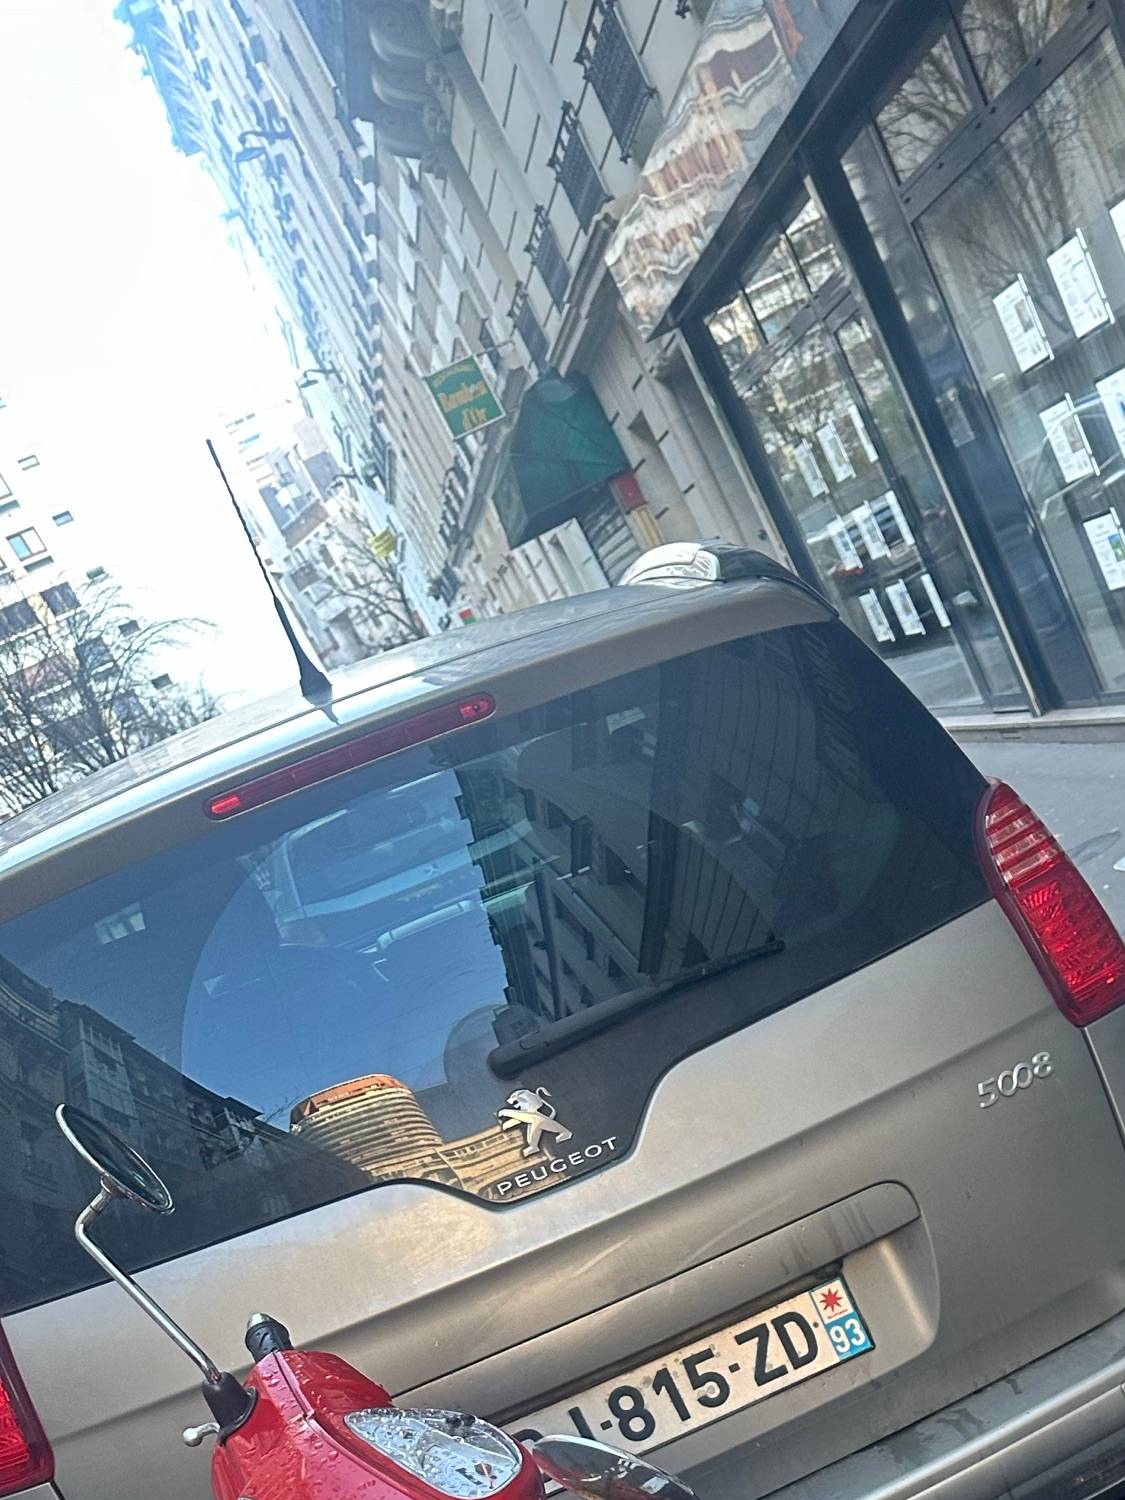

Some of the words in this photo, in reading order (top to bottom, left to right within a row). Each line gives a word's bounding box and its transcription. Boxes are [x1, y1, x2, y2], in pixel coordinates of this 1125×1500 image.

[977, 1051, 1054, 1109] 5008
[496, 1136, 617, 1196] PEUGEOT
[829, 1318, 866, 1353] 93
